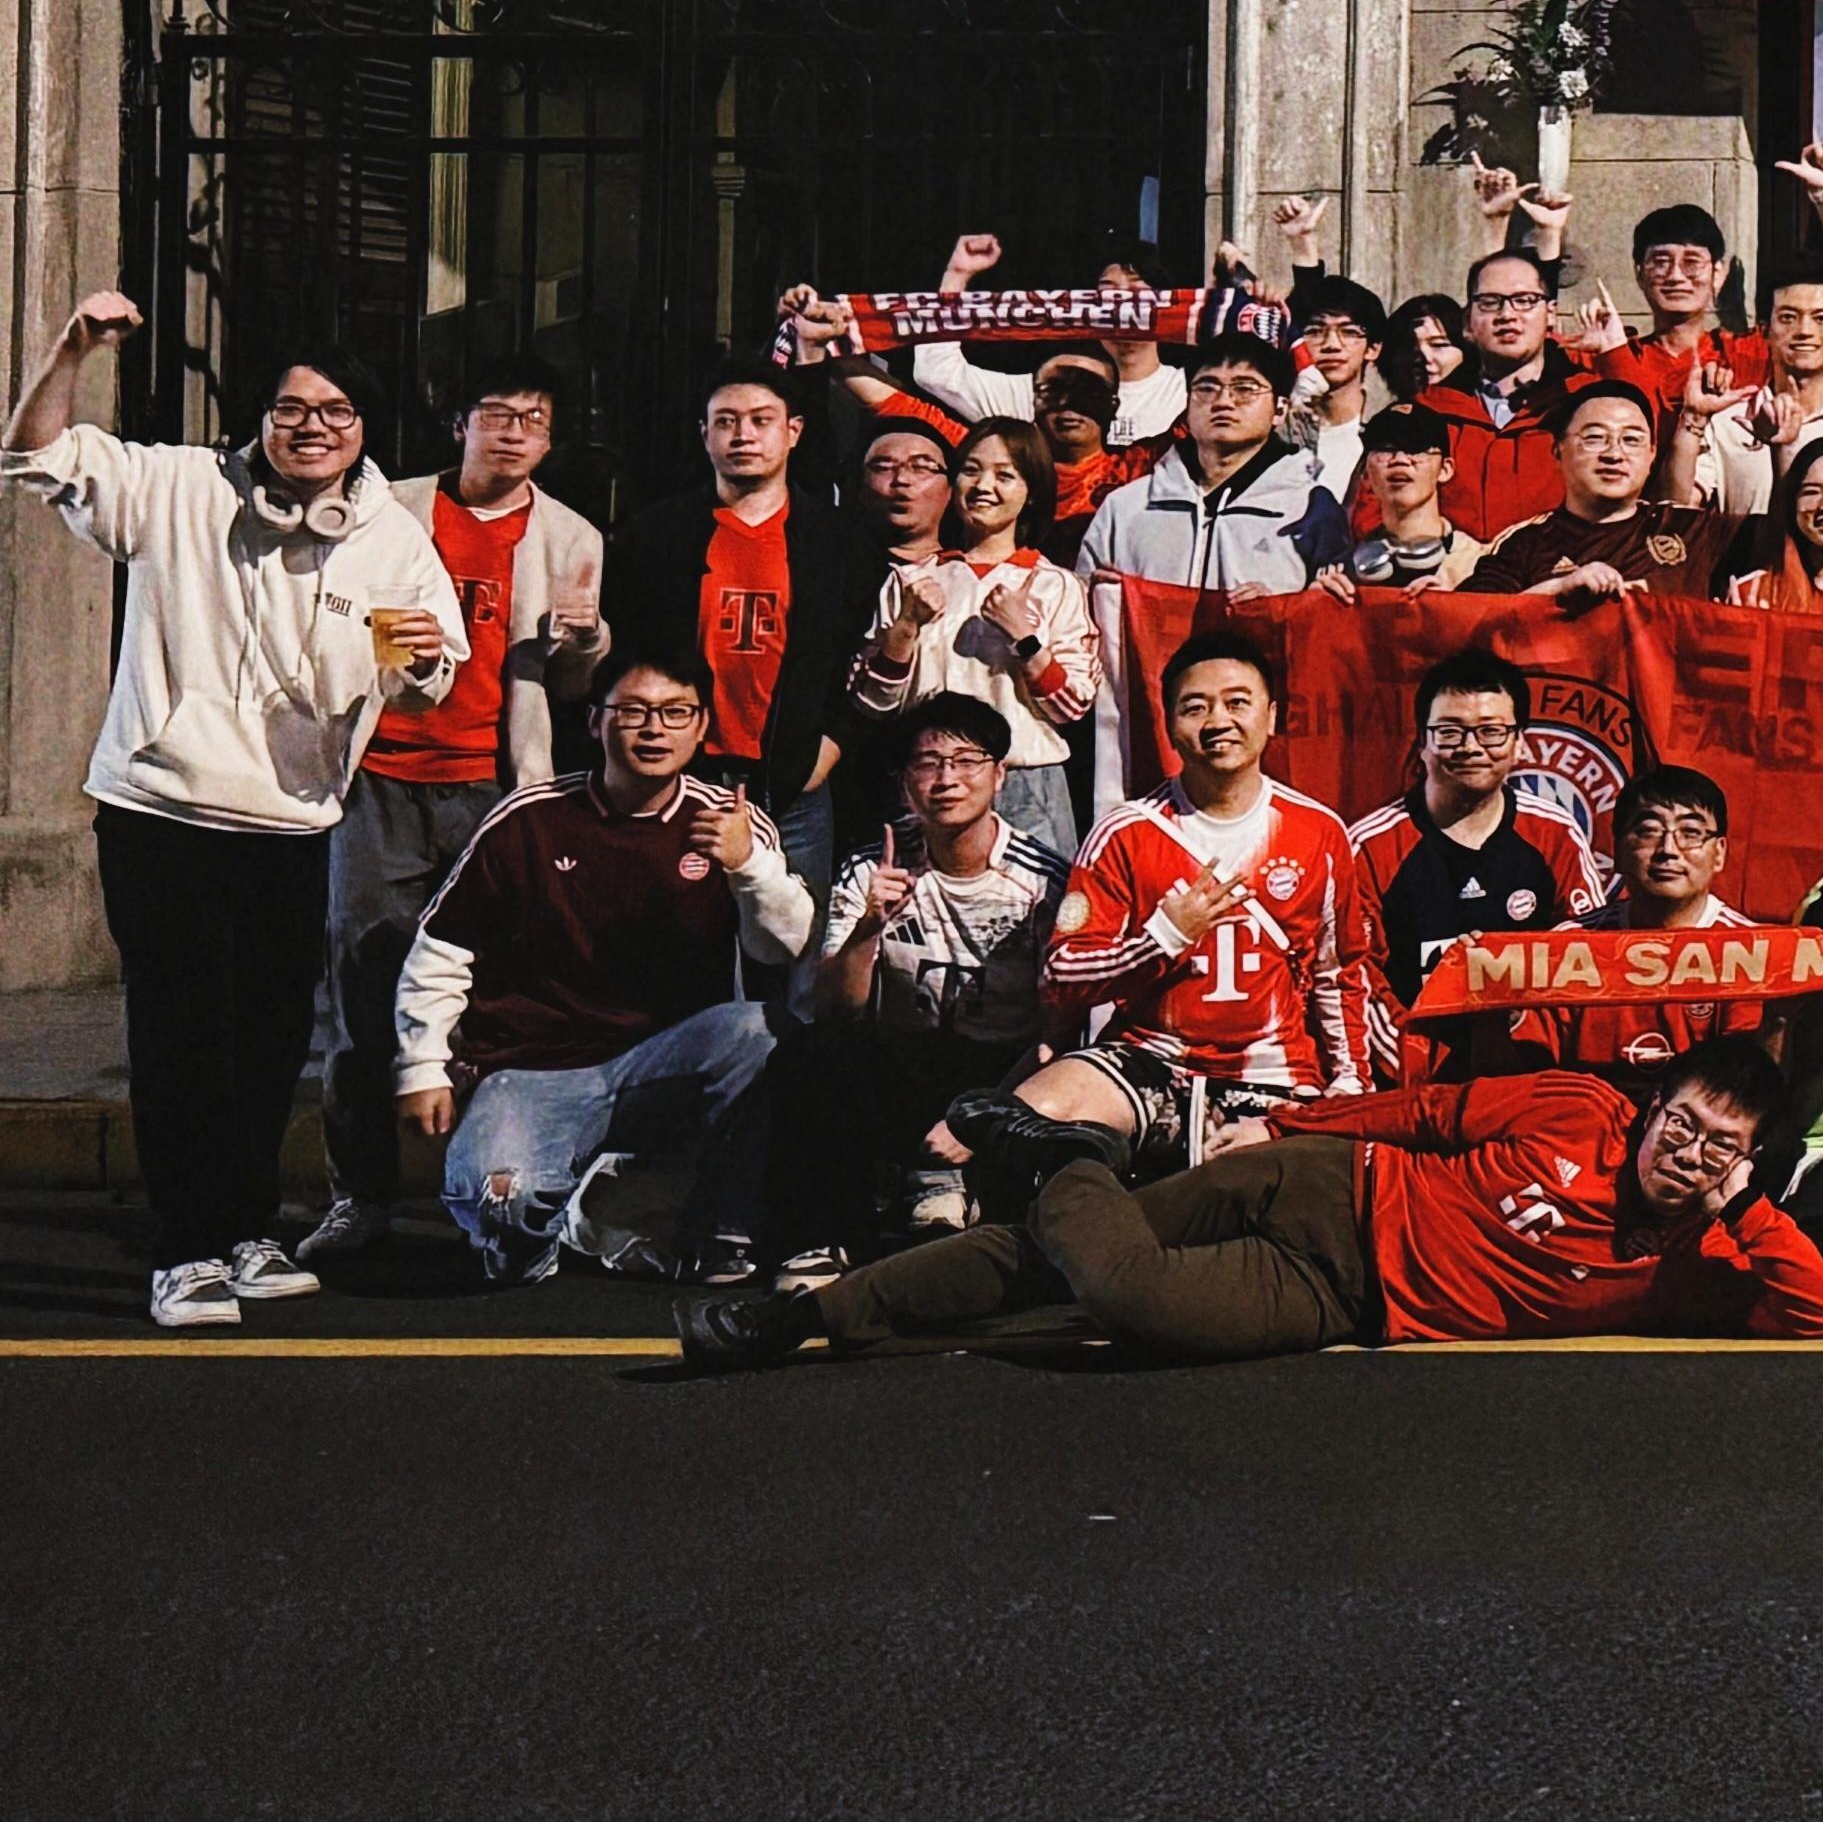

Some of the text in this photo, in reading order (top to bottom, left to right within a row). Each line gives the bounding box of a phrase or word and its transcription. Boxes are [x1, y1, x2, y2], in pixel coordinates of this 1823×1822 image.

[874, 292, 941, 311] FC
[720, 587, 781, 655] T
[1540, 684, 1632, 747] FANS
[1516, 732, 1617, 813] AYERN
[1466, 942, 1600, 991] MIA
[1624, 939, 1769, 986] SAN
